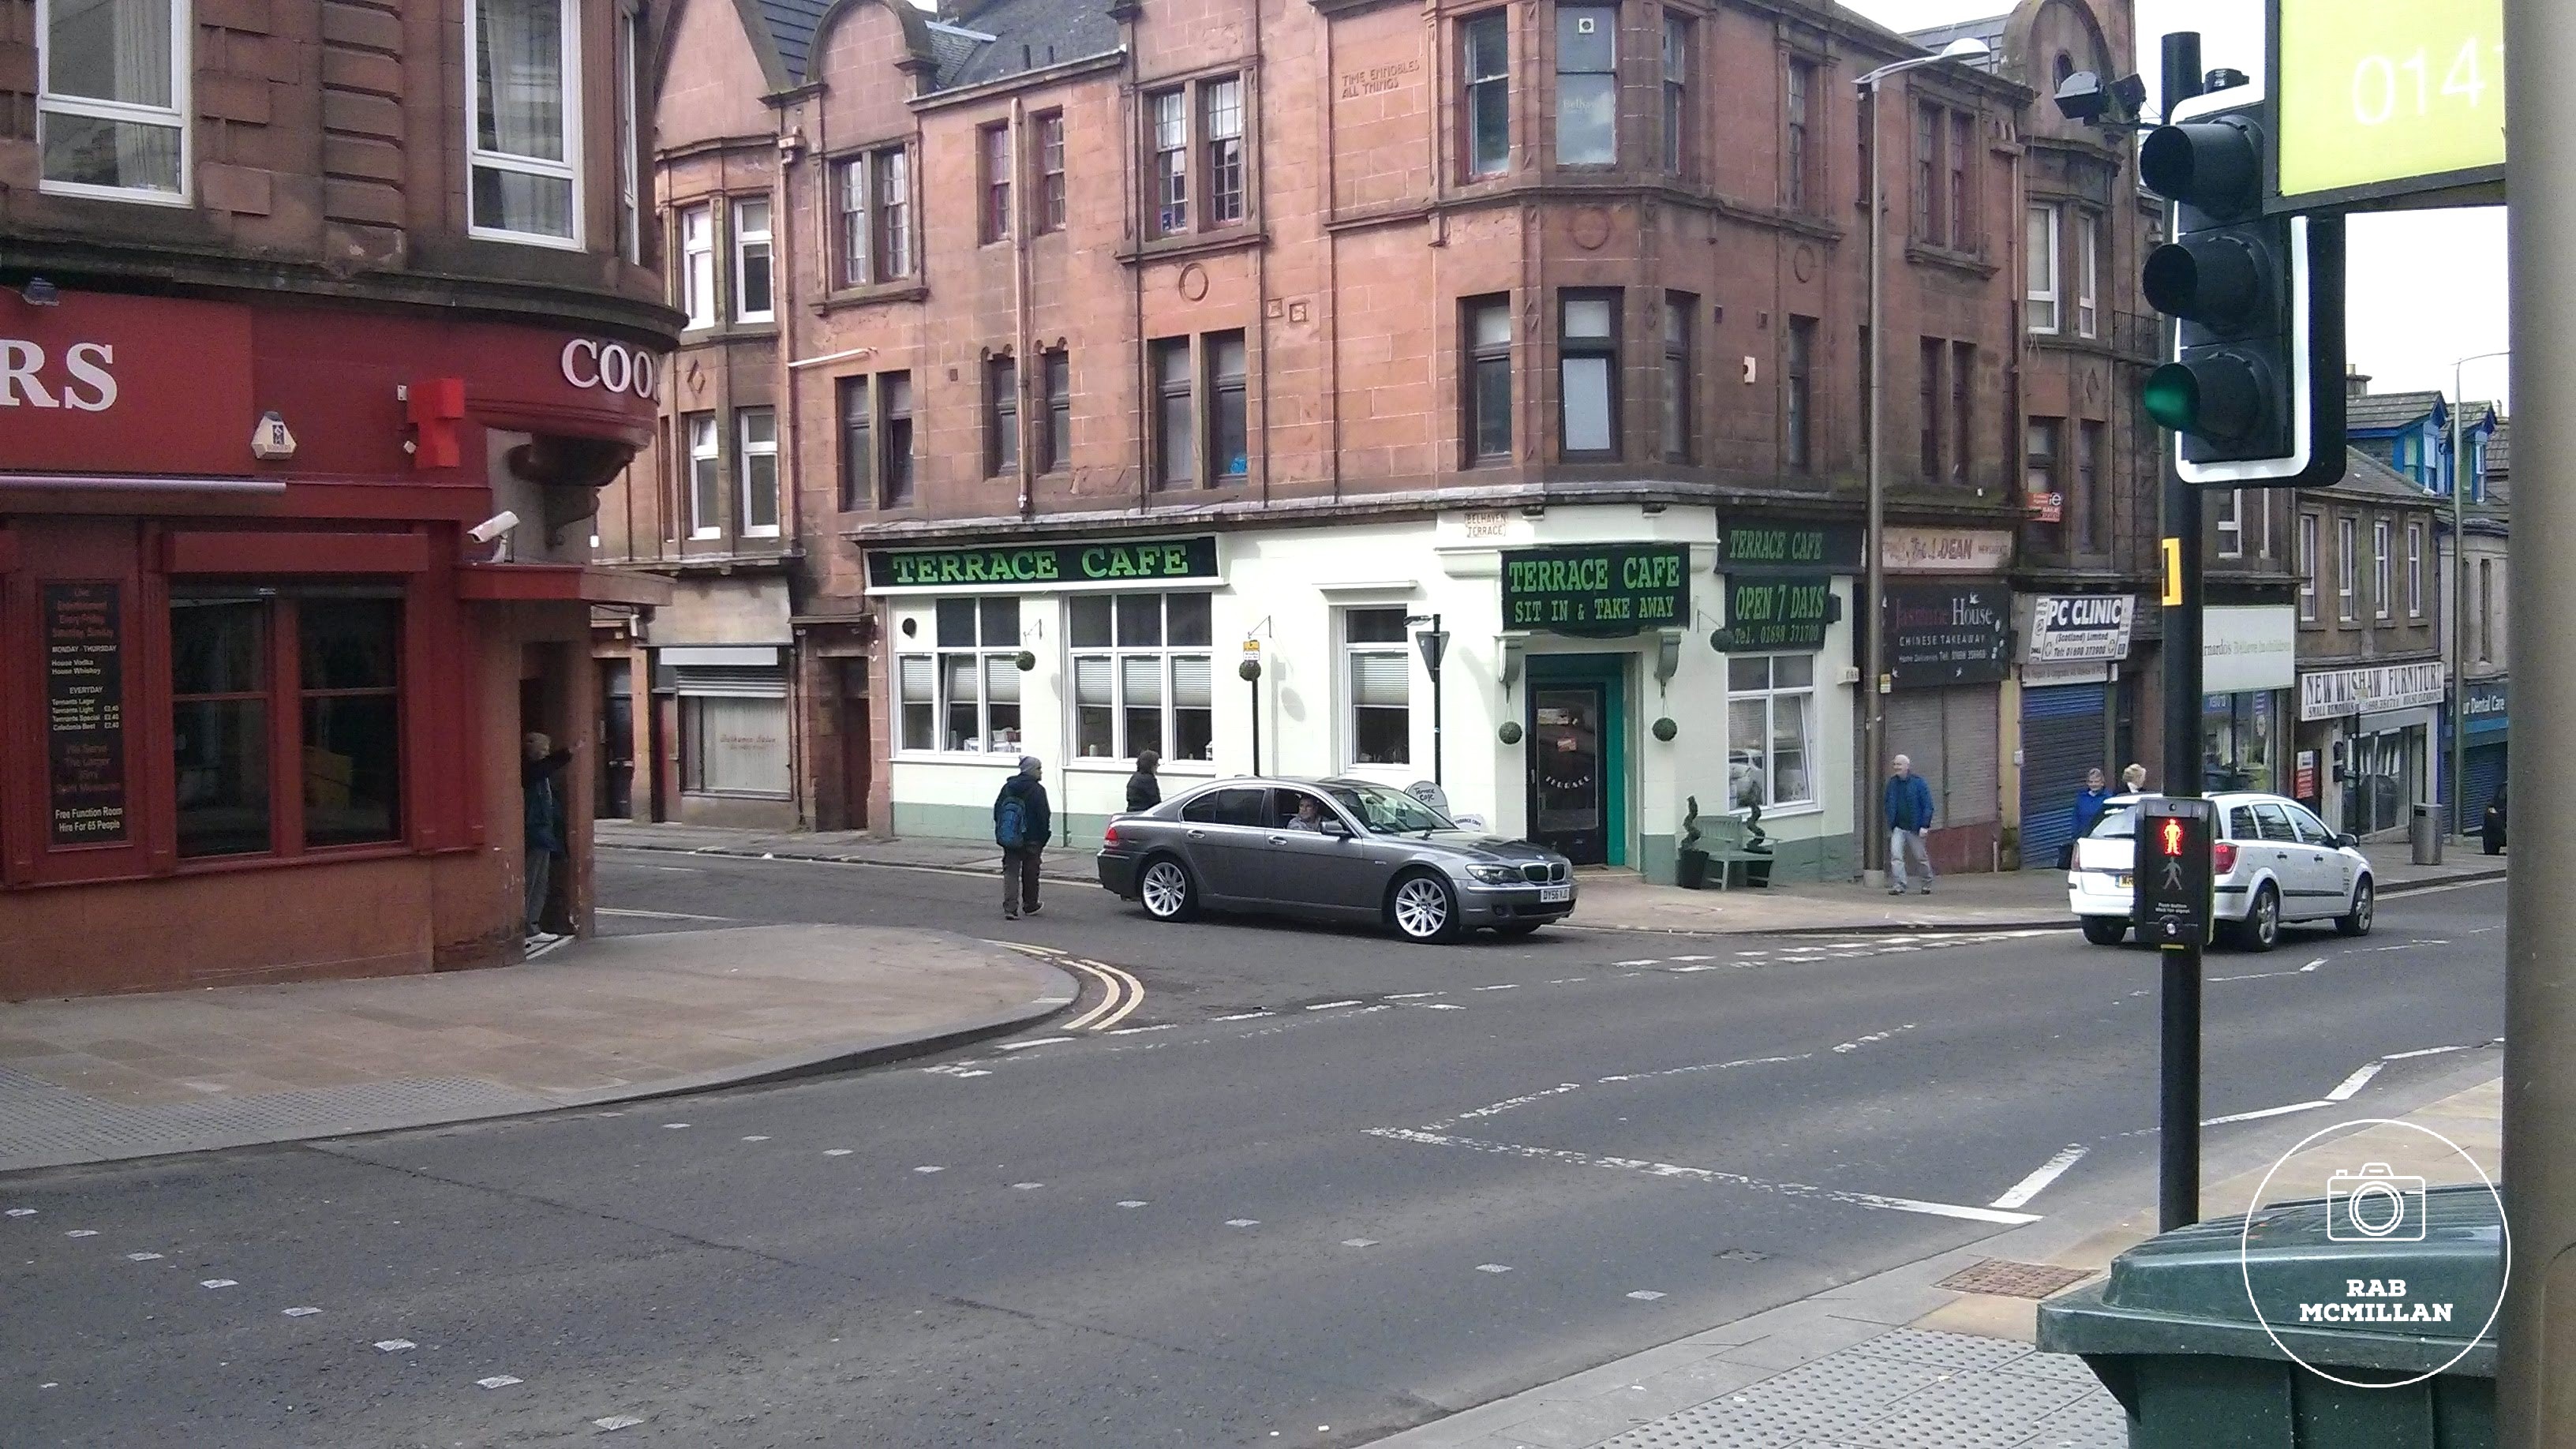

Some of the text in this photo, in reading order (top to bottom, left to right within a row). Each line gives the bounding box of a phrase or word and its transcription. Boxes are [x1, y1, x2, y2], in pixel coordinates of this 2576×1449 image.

[1342, 72, 1365, 86] TIME
[1342, 78, 1398, 99] ALL THINGS
[2352, 36, 2503, 125] 014
[0, 339, 118, 411] RS
[562, 339, 659, 400] COO
[1468, 514, 1507, 524] BELHAVEN
[1468, 526, 1503, 537] TERRACE
[1729, 530, 1823, 560] TERRACE CAFE
[893, 545, 1189, 583] TERRACE CAFE
[1508, 556, 1679, 592] TERRACE CAFE
[1515, 596, 1675, 623] SIT IN & TAKE AWAY
[1735, 584, 1825, 622] OPEN 7 DAYS
[1953, 597, 1993, 625] House
[2046, 599, 2121, 626] PC CLINIC
[1735, 627, 1754, 644] Tel.
[1760, 624, 1786, 644] 01698
[1899, 635, 1986, 646] CHINESE TAKEAWAY
[2055, 632, 2108, 644] (Scotland) Limited
[69, 686, 103, 695] EVERYDAY
[2306, 675, 2333, 706] NEW
[2335, 670, 2382, 702] WISHAW
[2470, 695, 2490, 713] Dental
[2492, 695, 2505, 711] Care
[1413, 787, 1436, 796] Terrace
[55, 806, 123, 819] Free Function Room
[59, 819, 121, 833] Hire For 65 People
